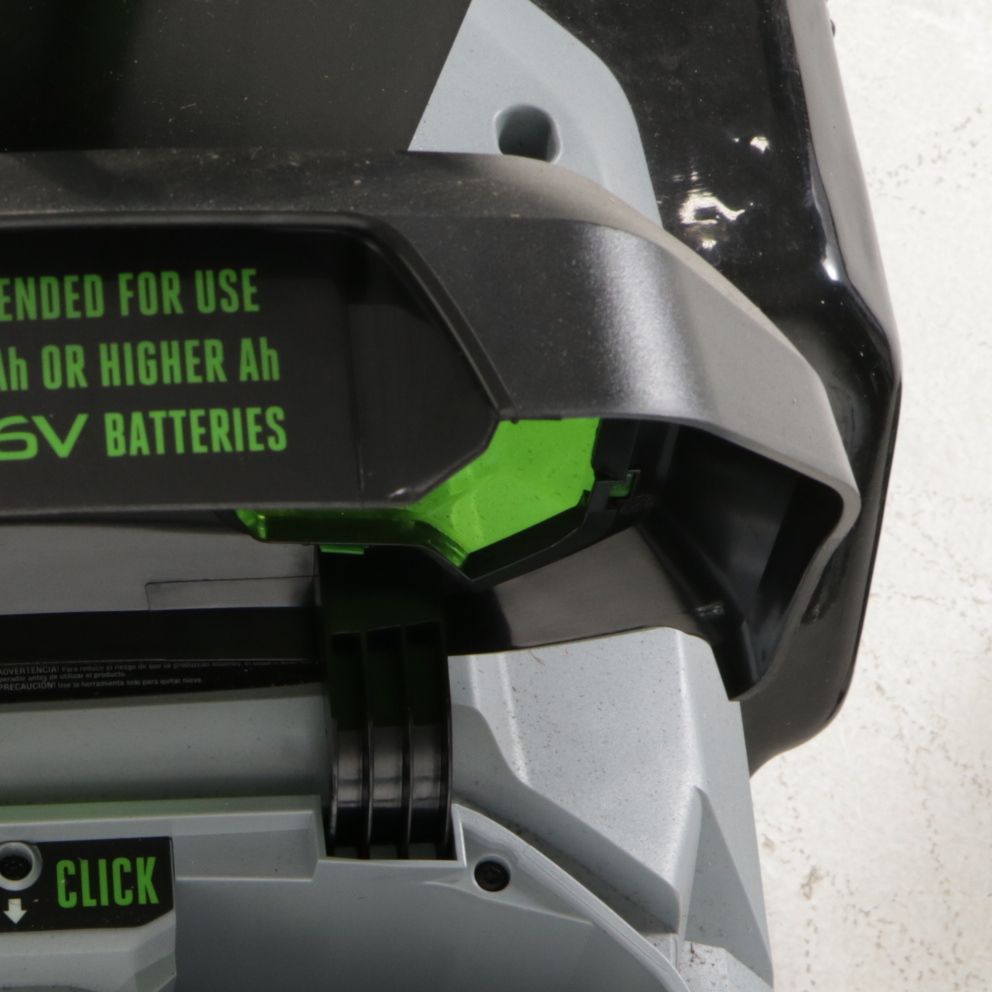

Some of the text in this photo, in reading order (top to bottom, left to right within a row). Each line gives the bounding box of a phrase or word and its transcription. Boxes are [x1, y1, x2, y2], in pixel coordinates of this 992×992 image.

[119, 271, 183, 316] FOR
[195, 268, 260, 314] USE
[41, 344, 88, 389] OR
[100, 339, 227, 386] HIGHER
[239, 336, 281, 382] Ah
[104, 406, 287, 457] BATTERIES
[56, 856, 159, 908] CLICK
